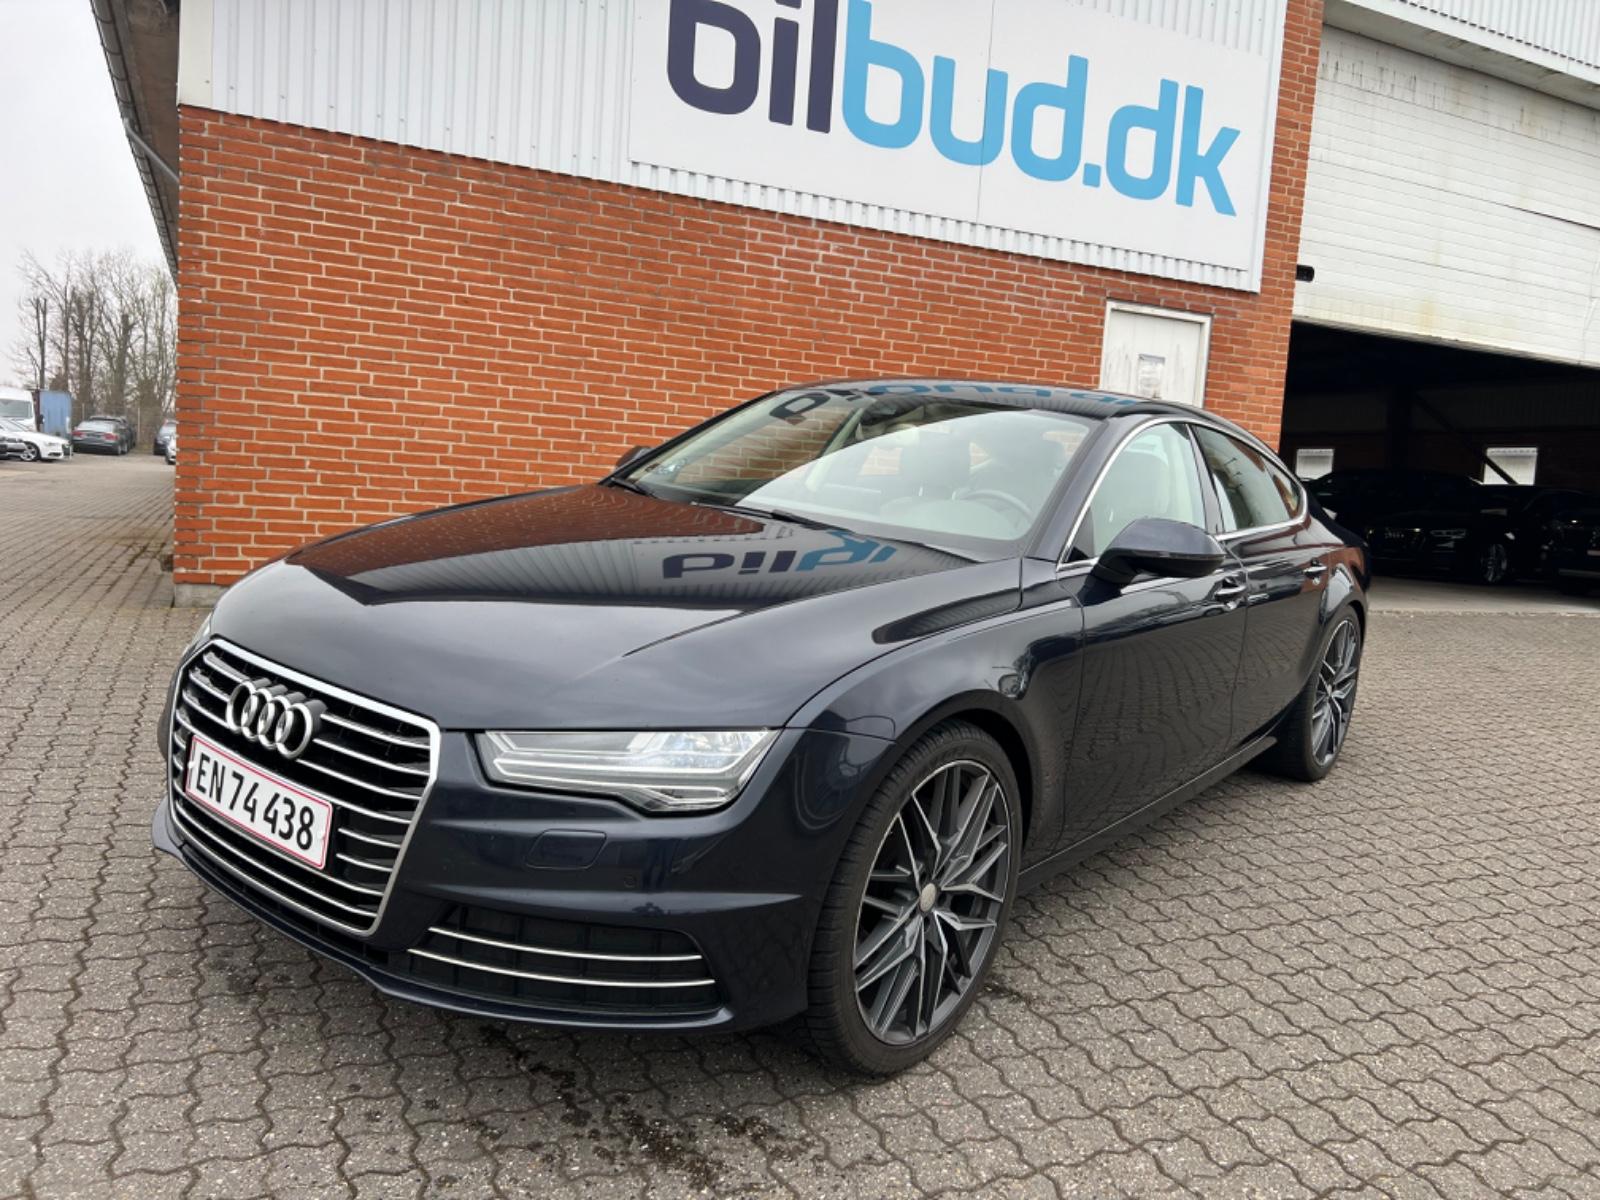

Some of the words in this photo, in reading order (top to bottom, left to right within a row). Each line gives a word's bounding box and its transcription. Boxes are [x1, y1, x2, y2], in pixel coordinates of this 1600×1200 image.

[667, 0, 1241, 217] bilbud.dk
[196, 752, 226, 804] EN
[263, 792, 315, 851] 438
